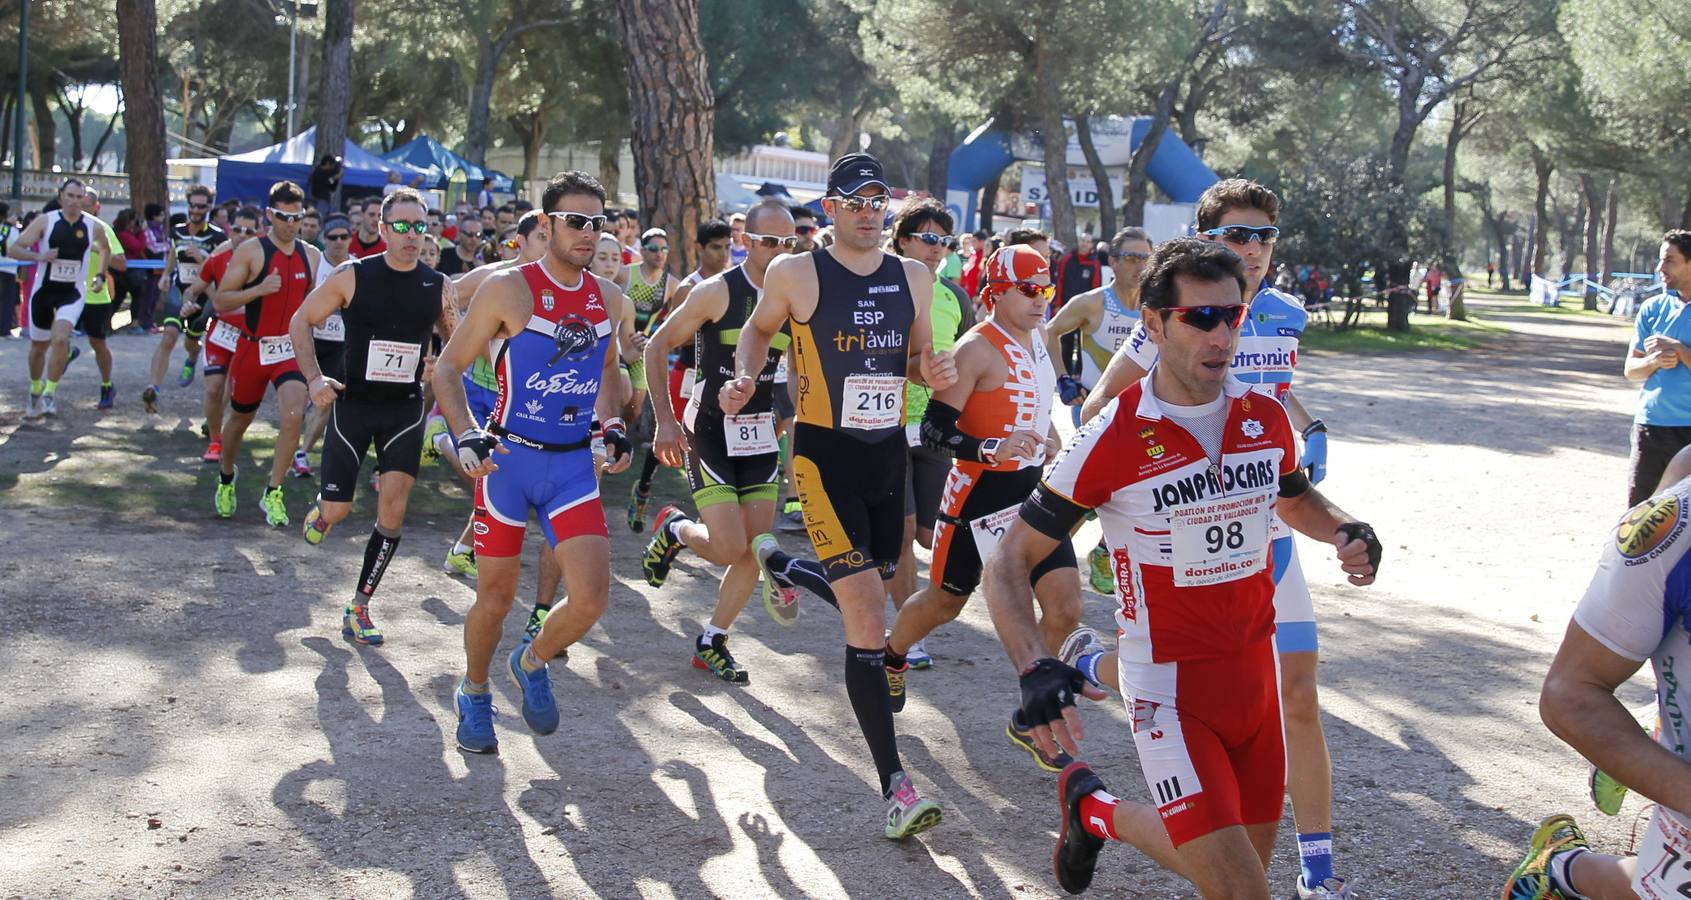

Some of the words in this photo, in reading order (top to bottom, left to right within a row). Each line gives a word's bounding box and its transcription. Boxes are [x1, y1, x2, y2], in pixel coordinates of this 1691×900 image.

[57, 267, 75, 275] 173
[853, 311, 885, 325] ESP
[268, 342, 292, 354] 212
[384, 353, 404, 368] 71
[857, 393, 895, 410] 216
[740, 426, 758, 440] 81
[1187, 516, 1212, 525] CIUDAD
[1224, 507, 1259, 520] VALLADOLID
[1207, 505, 1215, 513] DE
[1205, 521, 1244, 554] 98
[1185, 557, 1261, 576] dorsalia.com
